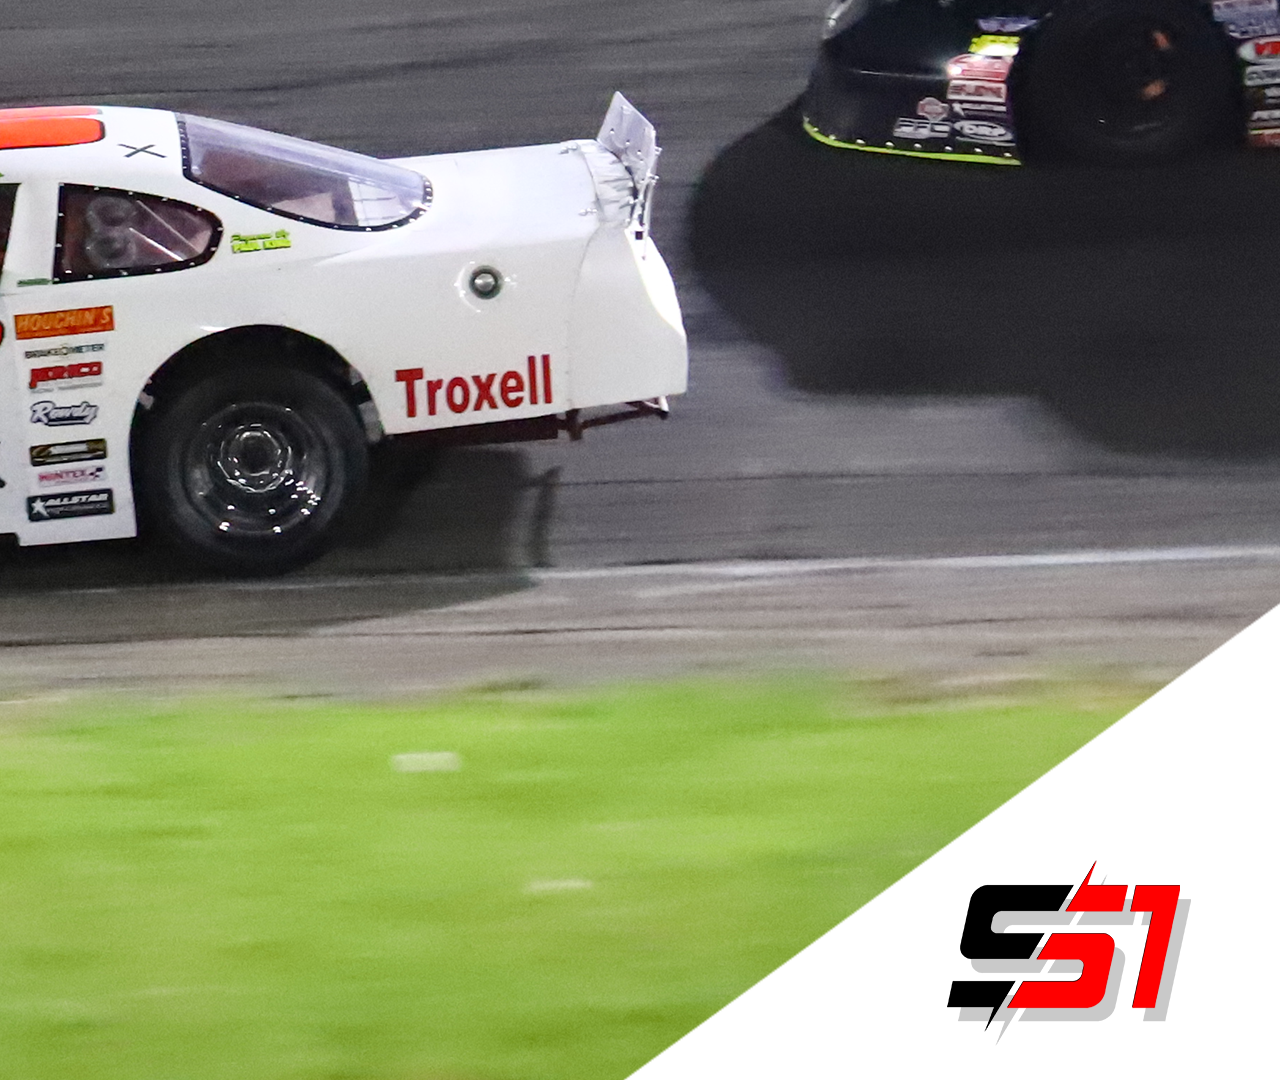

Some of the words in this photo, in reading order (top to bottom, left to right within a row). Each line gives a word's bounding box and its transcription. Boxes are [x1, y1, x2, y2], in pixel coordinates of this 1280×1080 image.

[395, 353, 553, 418] Troxell
[30, 400, 100, 427] Rowdy
[45, 493, 109, 507] ALLSTAR
